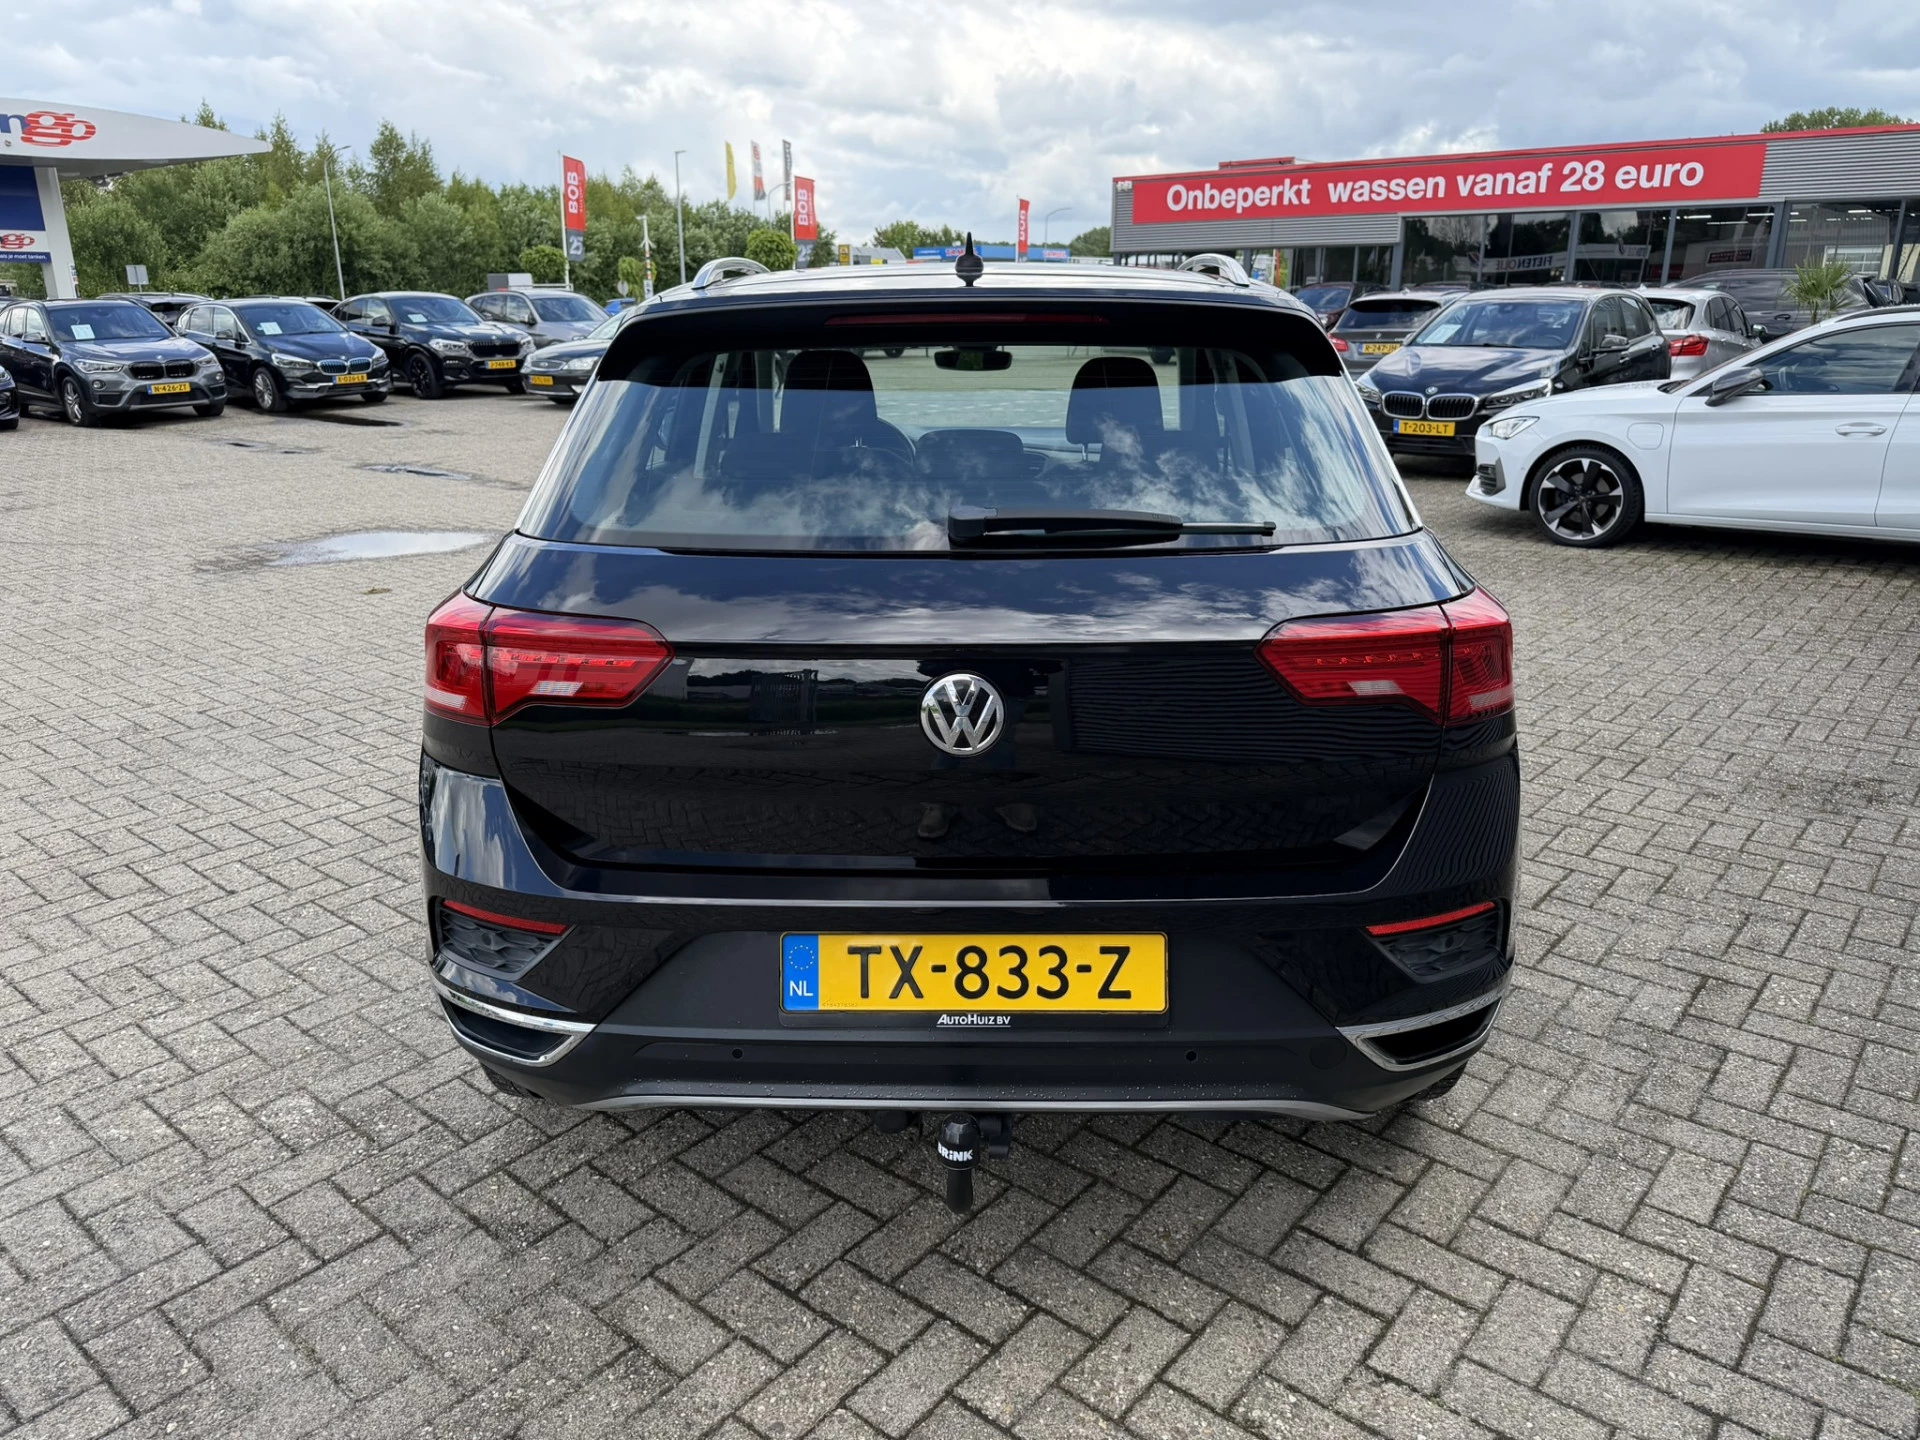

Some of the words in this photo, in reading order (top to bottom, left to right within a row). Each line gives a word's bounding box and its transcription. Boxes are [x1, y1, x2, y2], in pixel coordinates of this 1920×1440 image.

[567, 172, 579, 214] BOB
[1166, 178, 1311, 213] Onbeperkt
[1327, 176, 1445, 203] wassen
[1456, 162, 1553, 197] vanaf
[1559, 160, 1605, 192] 28
[1614, 161, 1704, 190] euro
[797, 189, 808, 226] BOB
[569, 236, 583, 255] 25
[154, 383, 187, 393] N-426-ZT
[1403, 422, 1449, 434] T-203-LT
[847, 945, 1132, 999] TX-833-Z
[789, 980, 814, 997] NL
[997, 1016, 1011, 1024] BV
